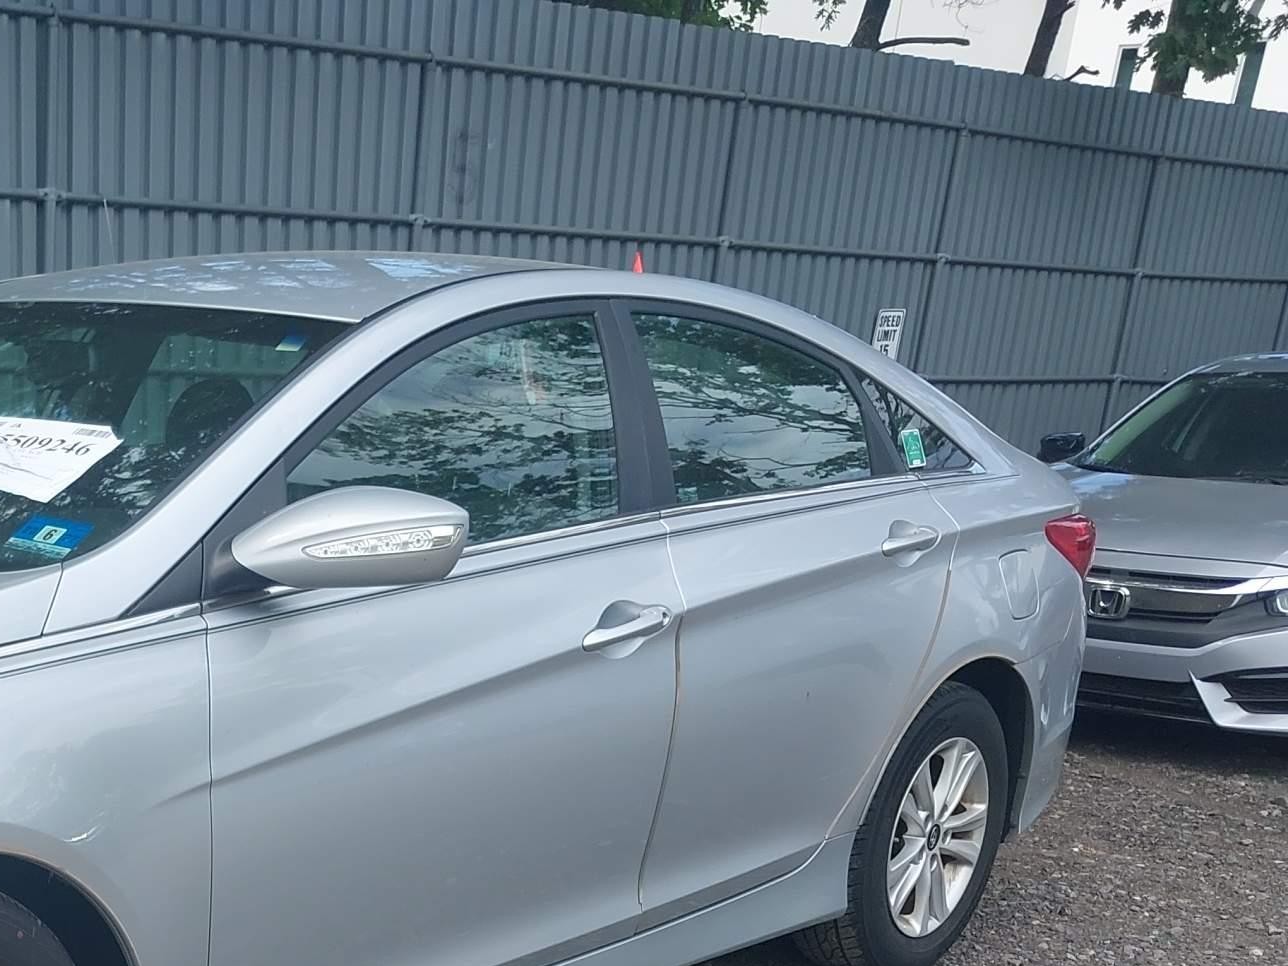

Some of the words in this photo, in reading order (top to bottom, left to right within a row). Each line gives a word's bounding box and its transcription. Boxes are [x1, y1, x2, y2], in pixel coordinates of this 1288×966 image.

[879, 315, 902, 327] SPEED
[876, 329, 898, 342] LIMIT
[42, 529, 58, 541] 6
